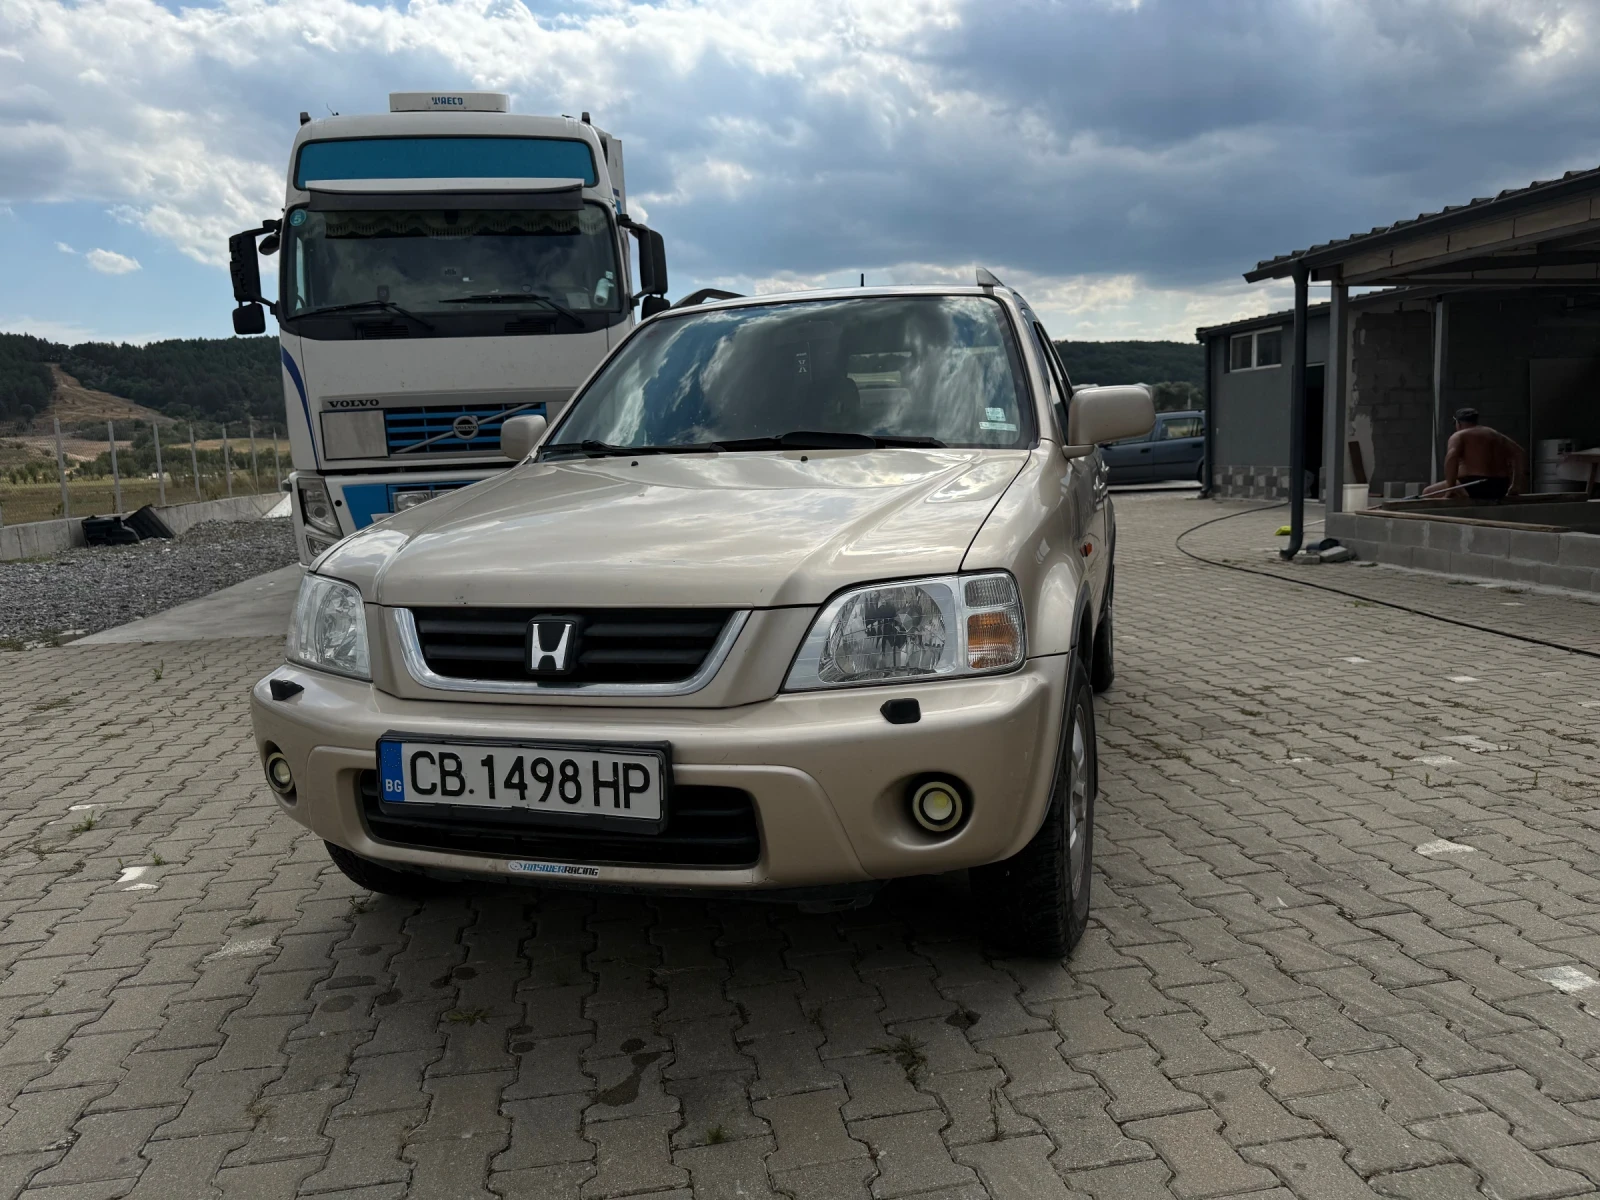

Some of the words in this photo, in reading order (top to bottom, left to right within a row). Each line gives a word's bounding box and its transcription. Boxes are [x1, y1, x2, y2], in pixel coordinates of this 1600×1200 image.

[431, 96, 464, 106] WAECO
[328, 398, 380, 408] VOLVO
[385, 779, 402, 793] BG
[592, 760, 651, 809] HP
